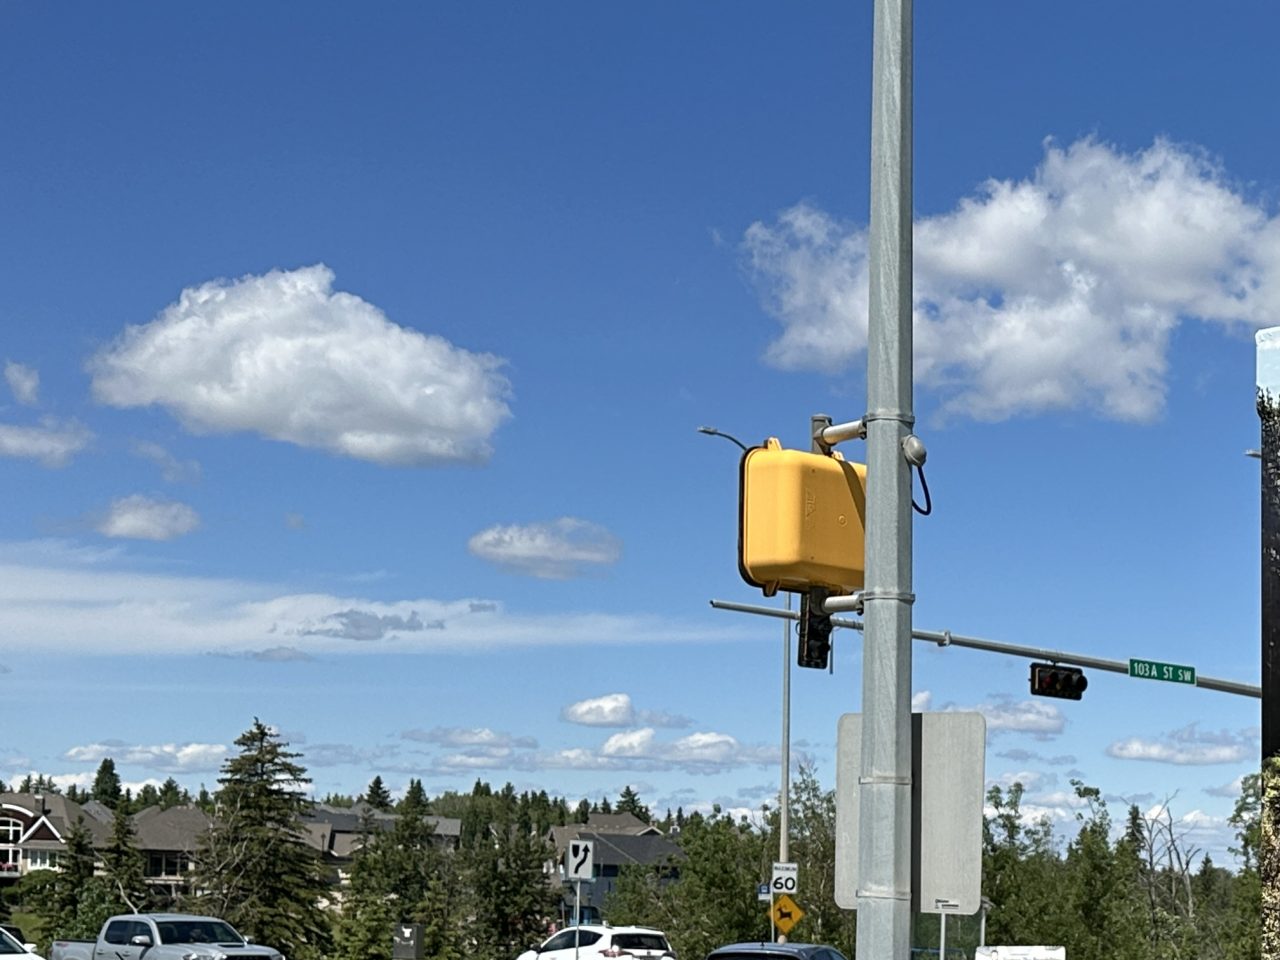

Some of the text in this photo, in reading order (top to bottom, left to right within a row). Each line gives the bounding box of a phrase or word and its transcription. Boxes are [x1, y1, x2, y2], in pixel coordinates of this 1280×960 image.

[1133, 662, 1192, 682] 103A ST SW
[773, 876, 796, 891] 60
